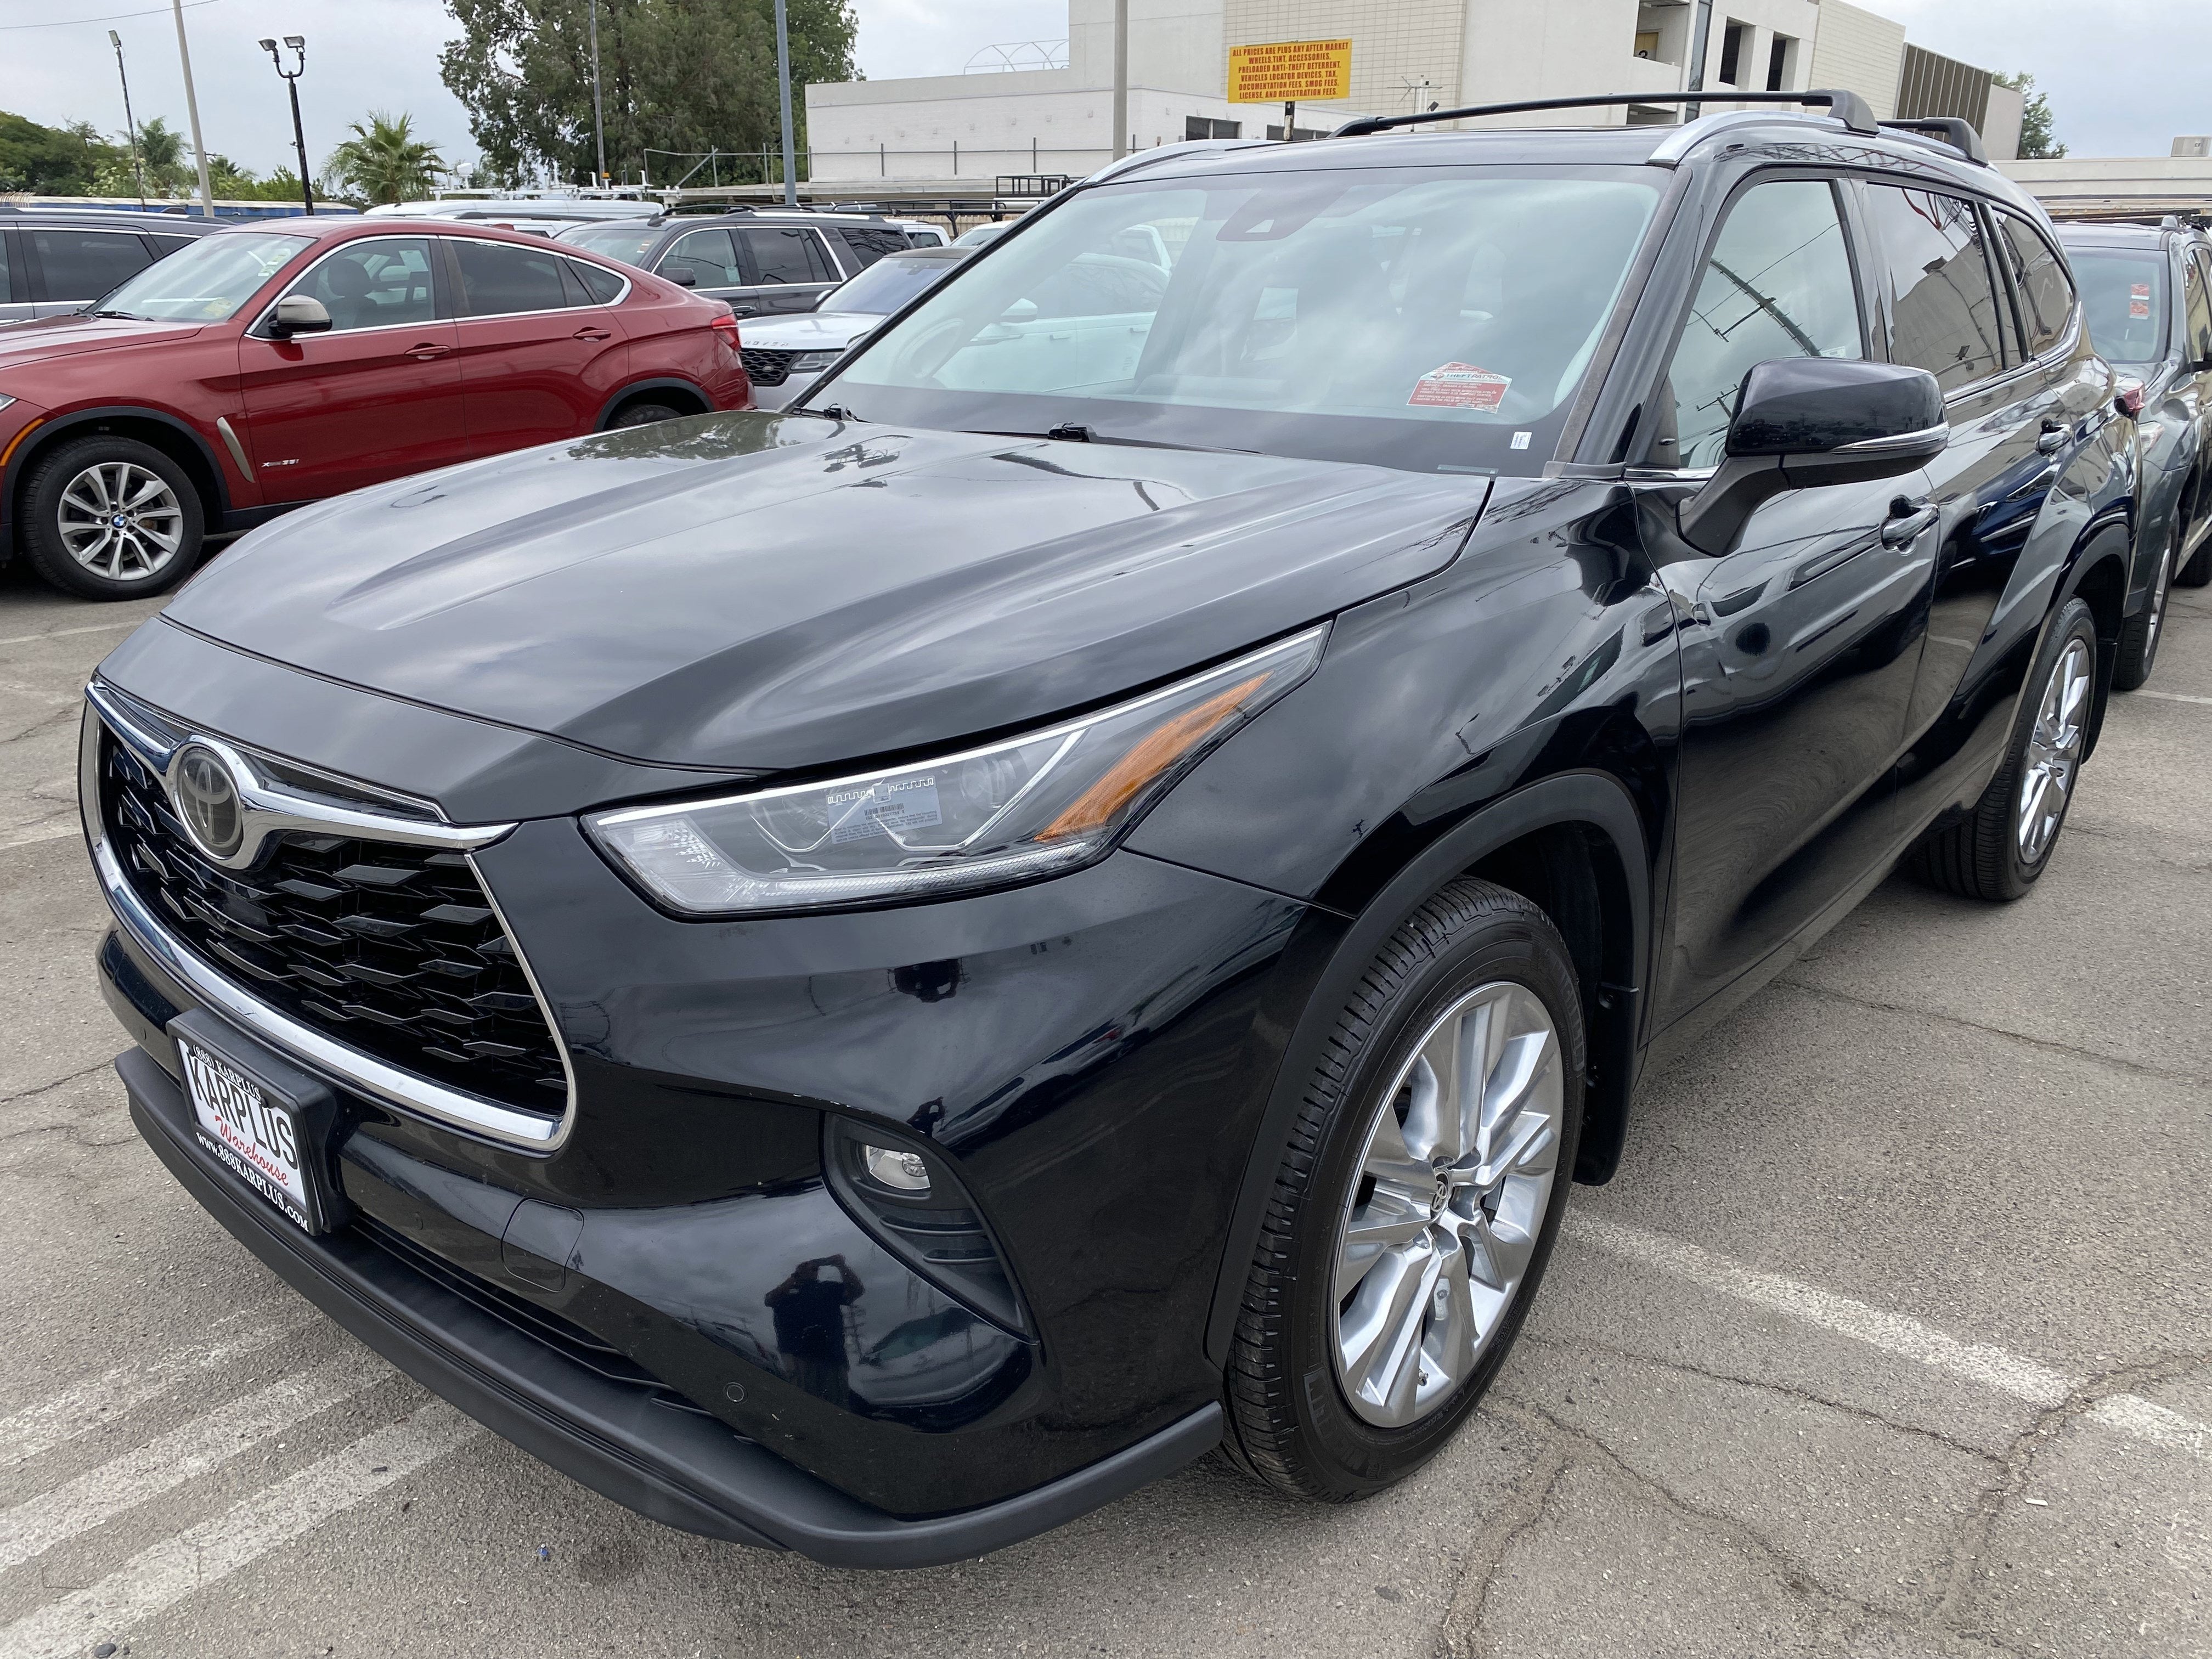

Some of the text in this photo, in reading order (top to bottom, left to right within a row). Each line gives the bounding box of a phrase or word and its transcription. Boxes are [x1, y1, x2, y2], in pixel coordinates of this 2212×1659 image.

[1325, 42, 1348, 50] MARKET
[1241, 74, 1267, 82] VEHICLES
[1269, 72, 1295, 80] LOCATOR
[1239, 82, 1287, 91] DOCUMENTATION
[1279, 88, 1321, 97] REGISTRATION
[193, 1045, 261, 1102] (888) KARPLUS
[189, 1054, 298, 1170] KARPLUS
[215, 1115, 289, 1186] Warehouse
